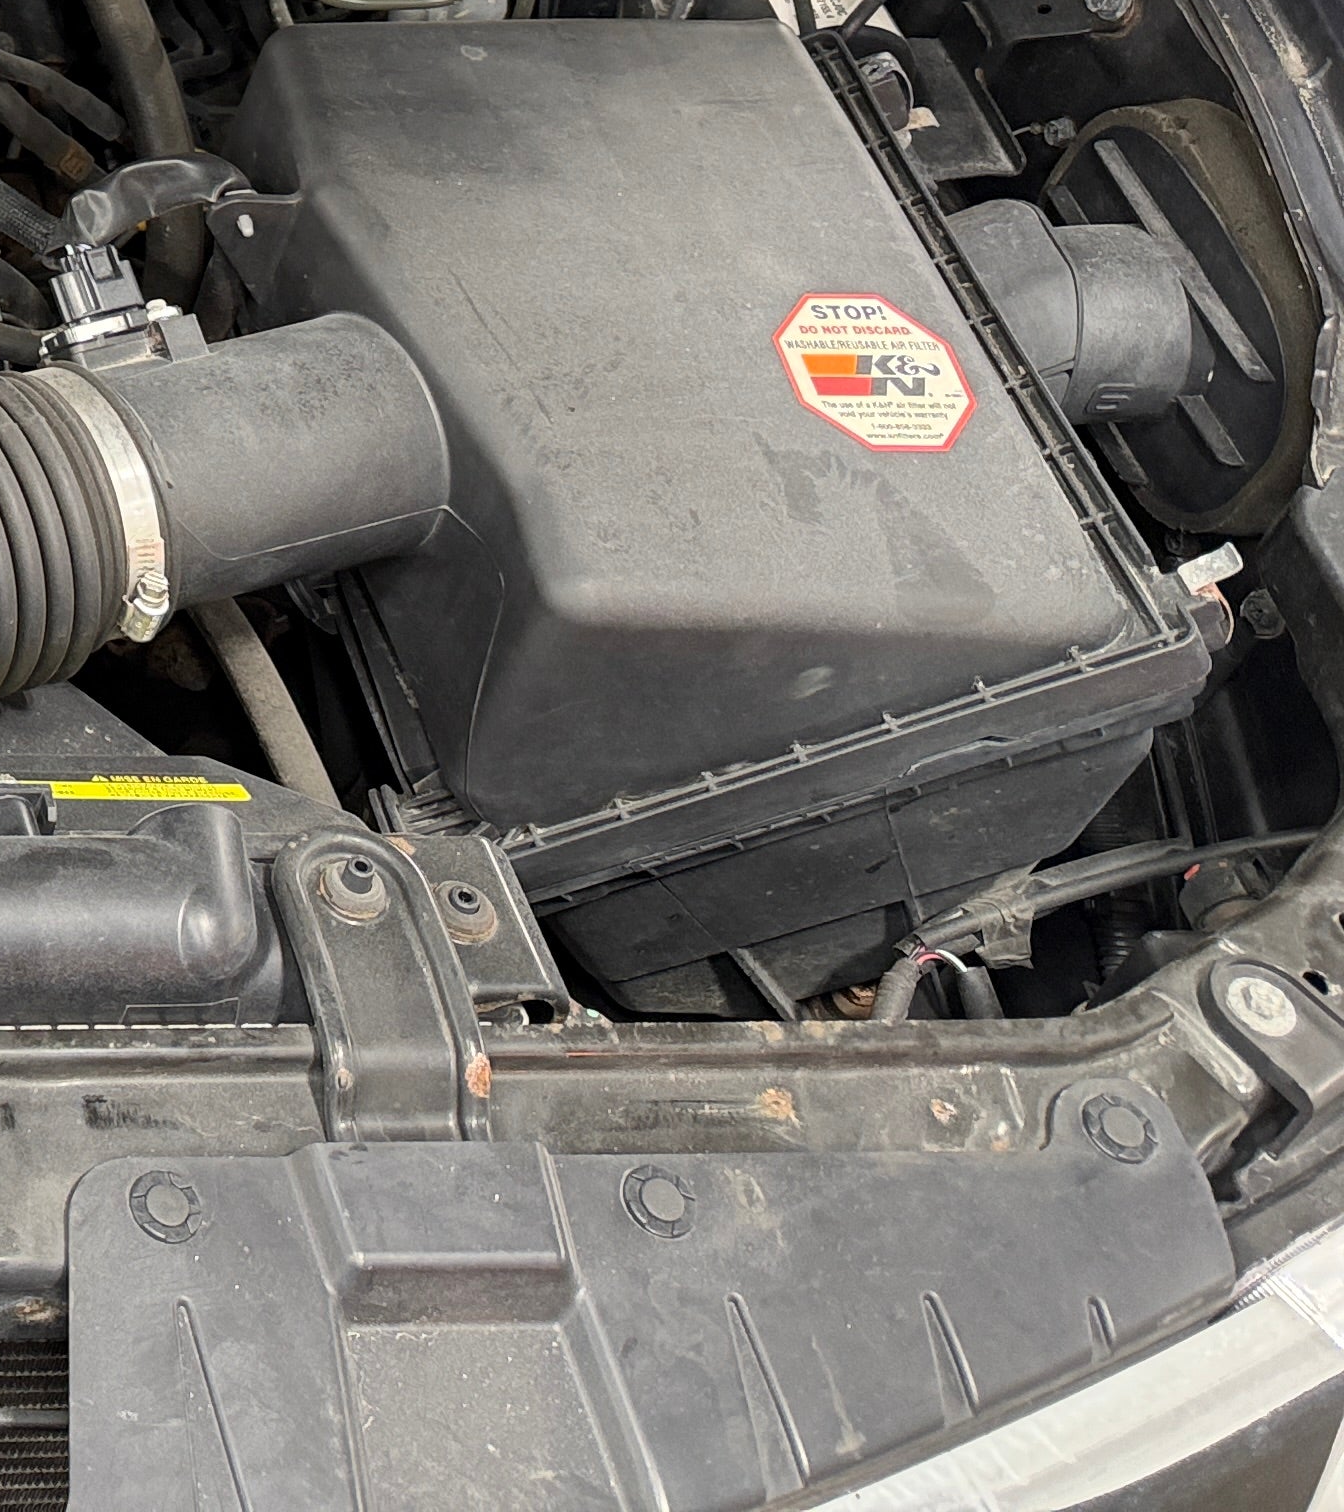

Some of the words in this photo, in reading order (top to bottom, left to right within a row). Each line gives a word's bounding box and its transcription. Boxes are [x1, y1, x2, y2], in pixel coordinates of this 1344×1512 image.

[811, 304, 887, 320] STOP!
[799, 326, 818, 334] DO
[822, 326, 848, 335] NOT
[784, 339, 889, 351] WASHABLE/REUSABLE
[891, 342, 907, 351] AIR
[909, 342, 940, 352] FILTER
